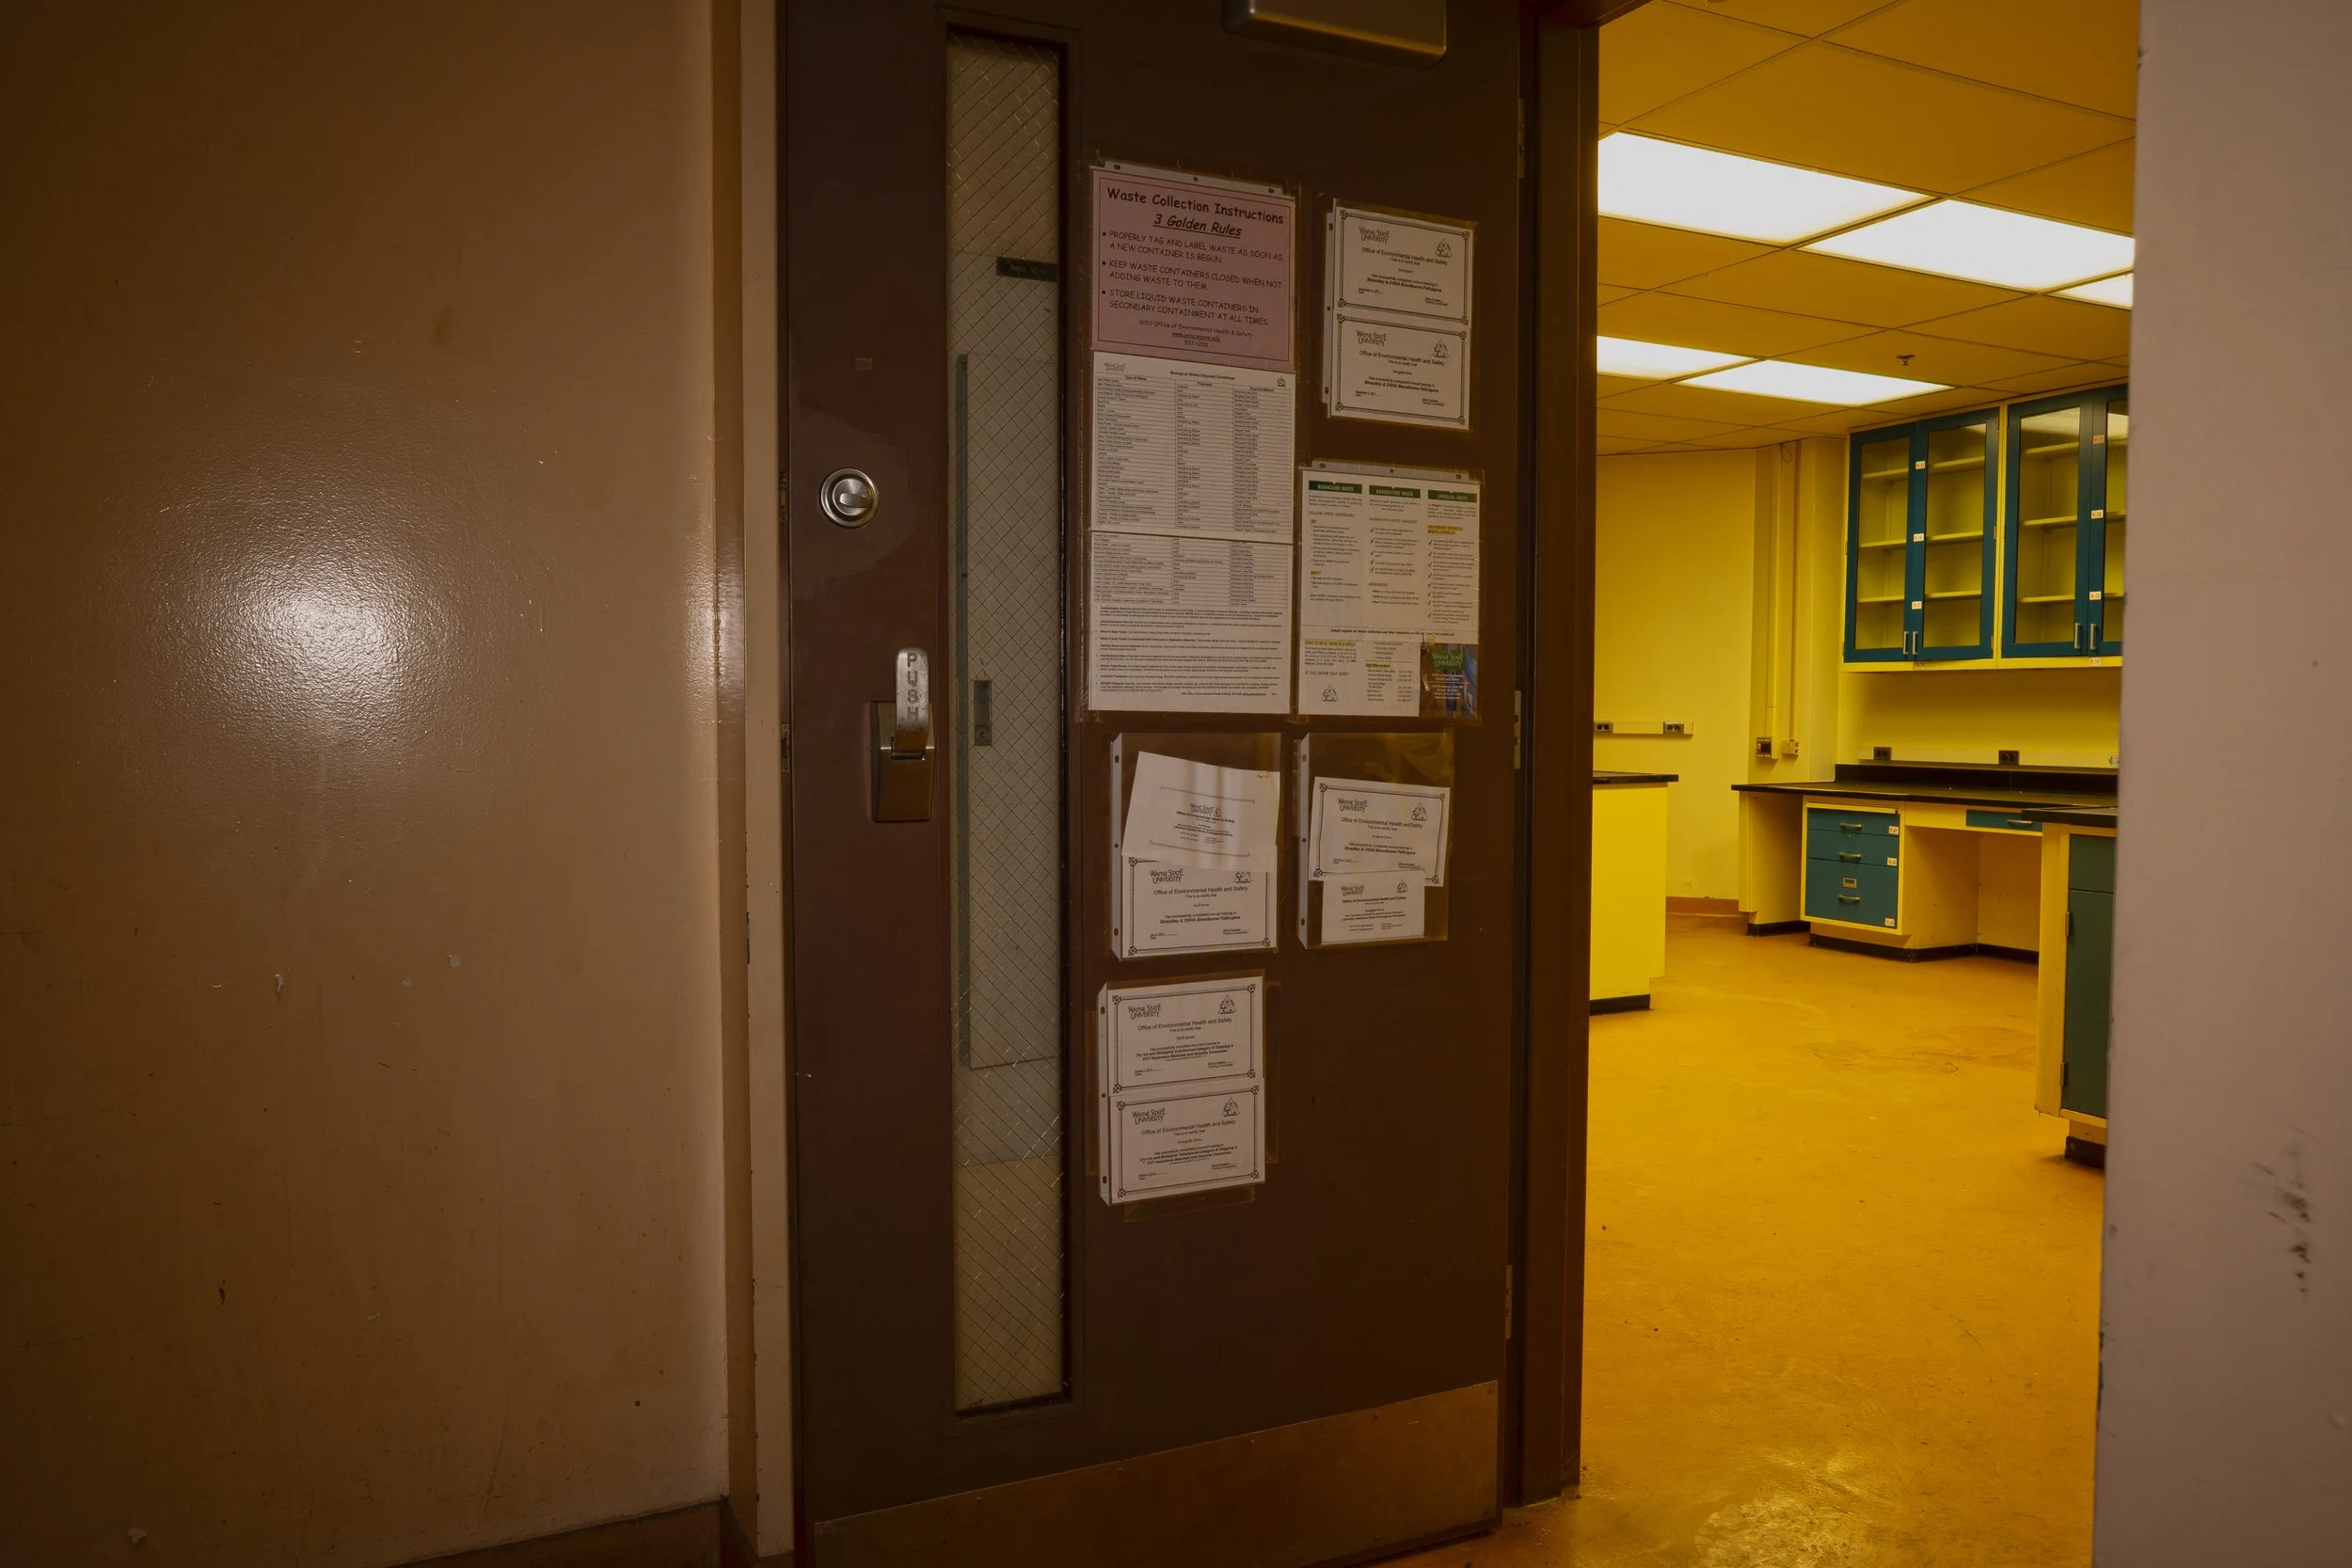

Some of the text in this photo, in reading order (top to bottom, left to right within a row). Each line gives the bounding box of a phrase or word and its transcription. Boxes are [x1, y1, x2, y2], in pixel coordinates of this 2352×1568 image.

[1107, 186, 1284, 224] Waste Collection Instructions
[1153, 214, 1242, 236] 3 Golden Rules
[1109, 230, 1146, 242] PROPERLY
[1149, 236, 1164, 245] TAG
[1167, 239, 1183, 247] AND
[1184, 241, 1207, 250] LABEL
[1209, 245, 1236, 255] WASTE
[1250, 251, 1271, 260] SOON
[1117, 243, 1136, 252] NEW
[1137, 246, 1184, 258] CONTAINER
[1197, 253, 1223, 263] BEGUN.
[1110, 260, 1127, 268] KEEP
[1130, 261, 1157, 272] WASTE
[1159, 266, 1210, 278] CONTAINERS
[1212, 273, 1240, 283] CLOSED
[1242, 277, 1264, 286] WHEN
[1110, 272, 1140, 281] ADDING
[1143, 276, 1170, 285] WASTE
[1185, 280, 1209, 291] THEM.
[1109, 289, 1135, 298] STORE
[1136, 292, 1167, 302] LIQUID
[1168, 295, 1196, 306] WASTE
[1198, 299, 1247, 311] CONTAINERS
[1109, 300, 1155, 312] SECONDARY
[1157, 306, 1216, 318] CONTAINMENT
[1230, 314, 1242, 323] ALL
[1245, 316, 1270, 325] TIMES.
[1178, 324, 1212, 332] Environmental
[907, 652, 919, 721] PUSH
